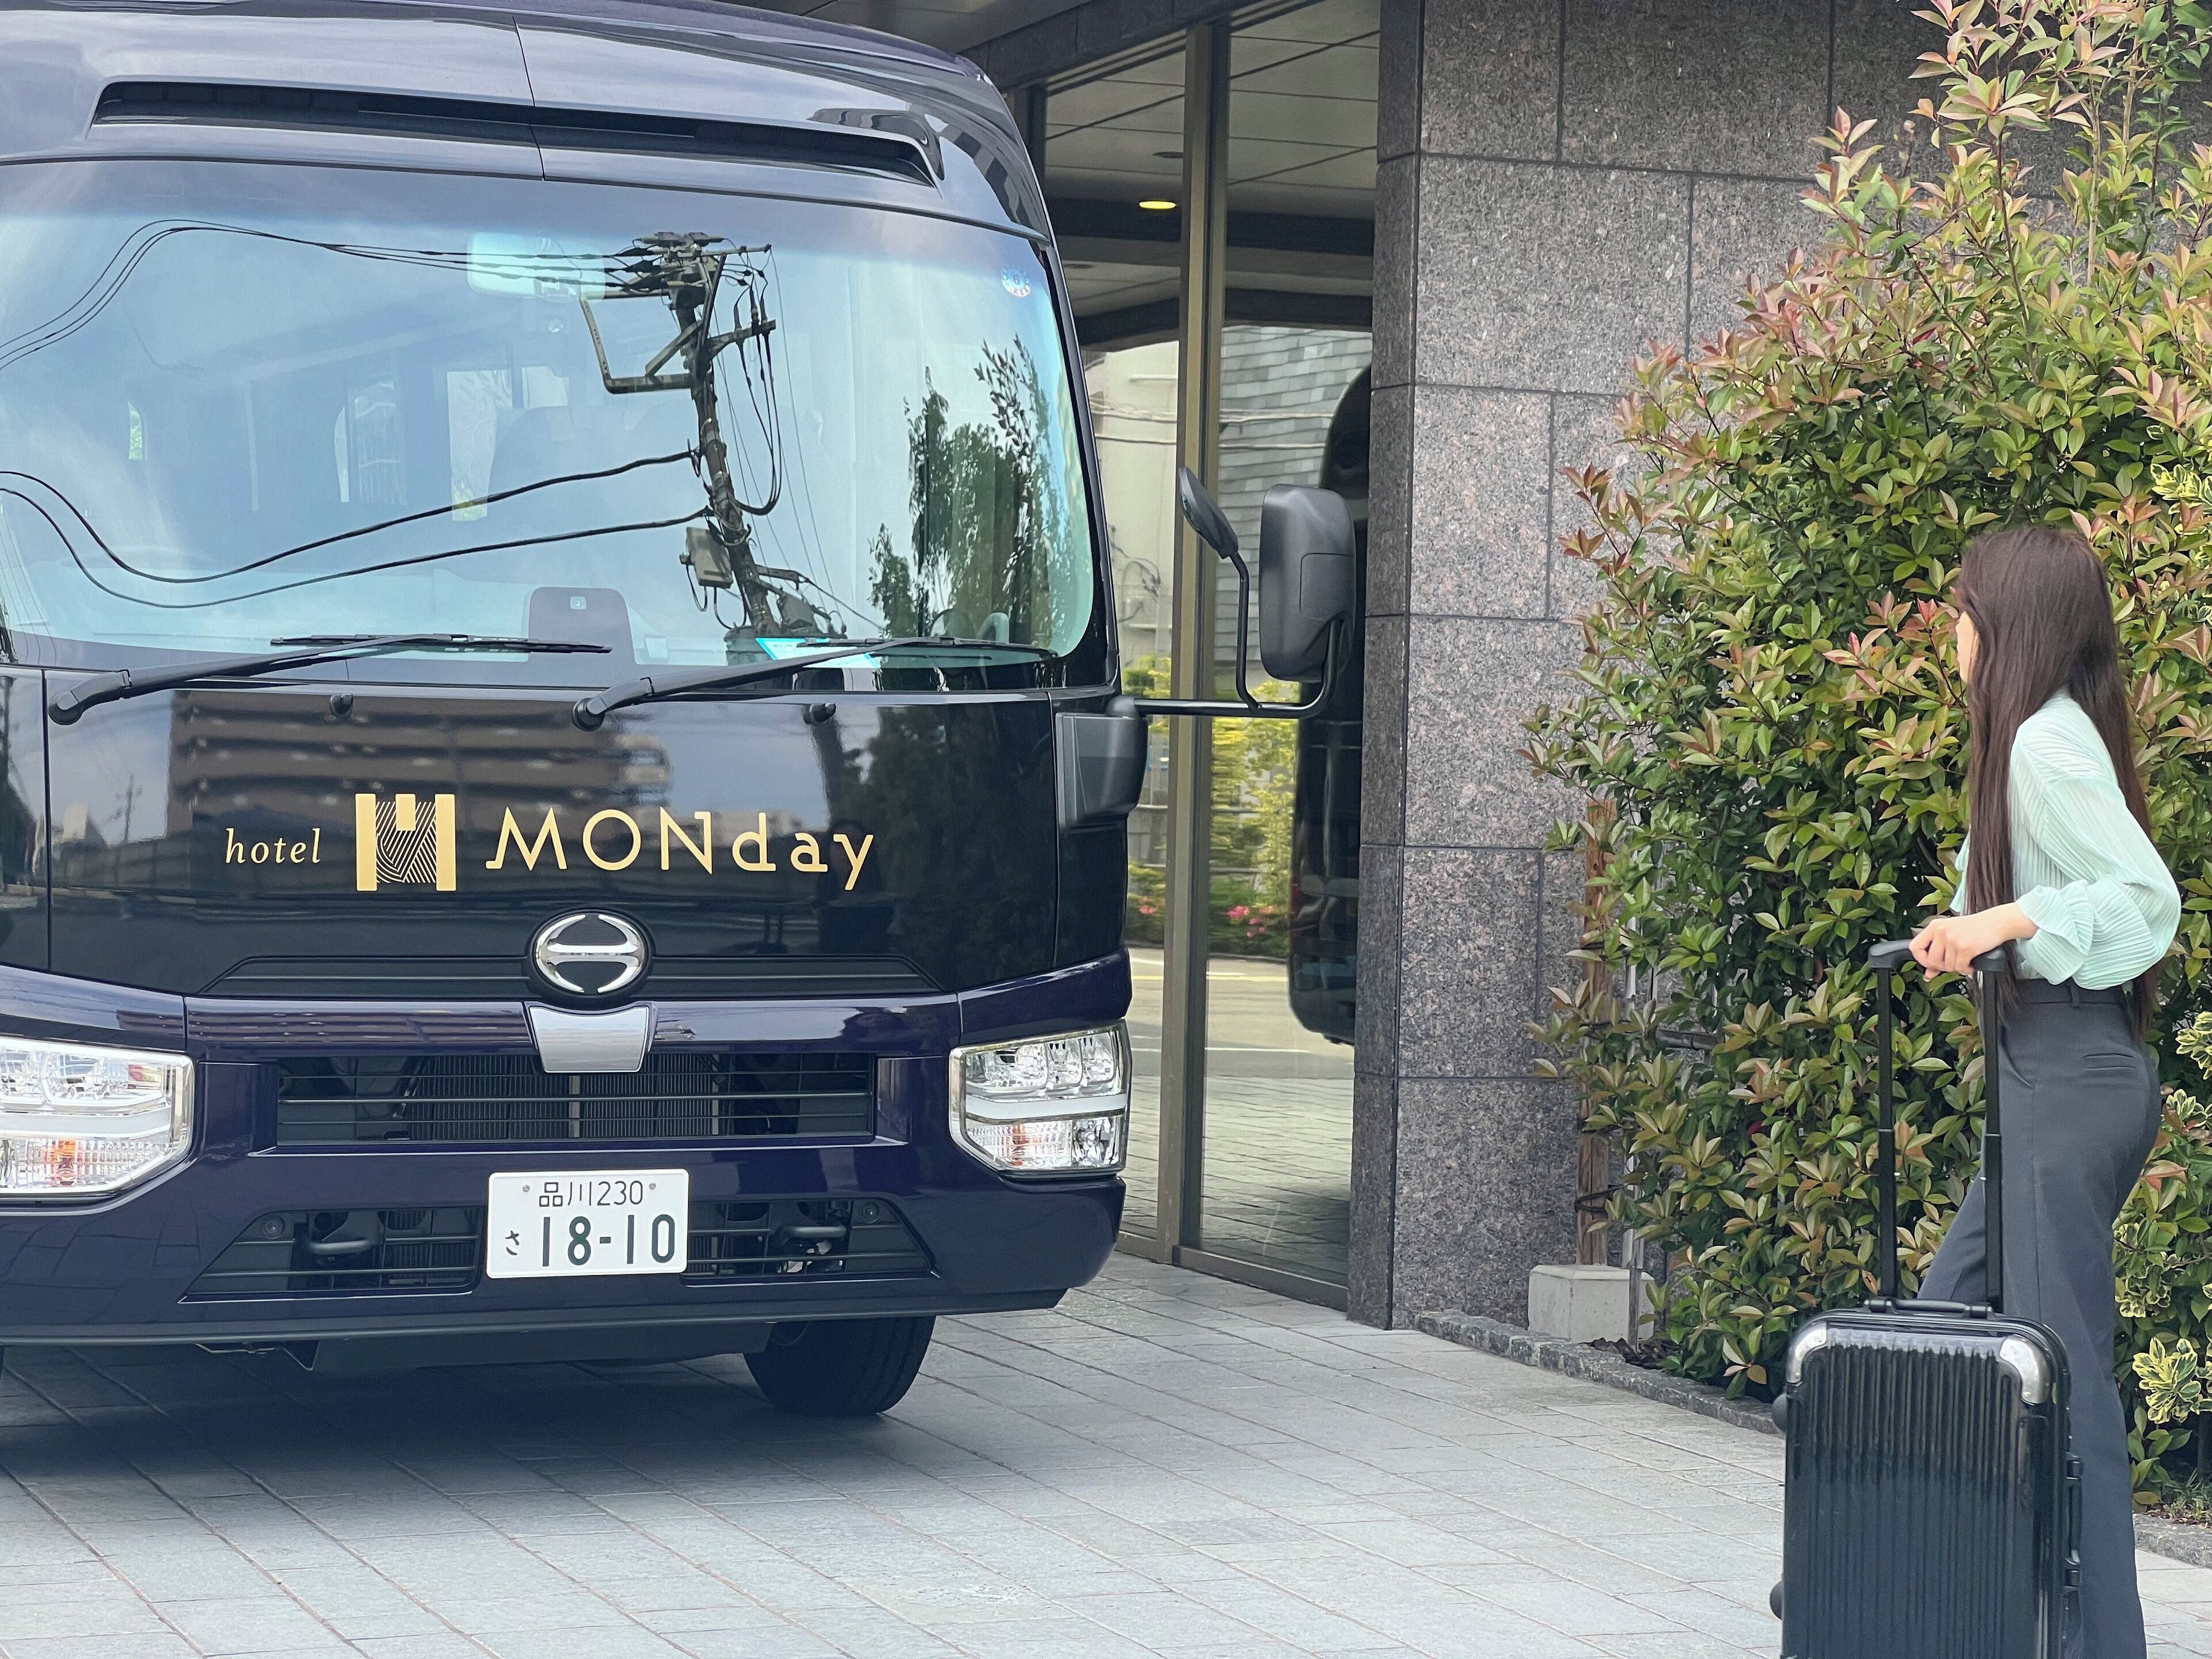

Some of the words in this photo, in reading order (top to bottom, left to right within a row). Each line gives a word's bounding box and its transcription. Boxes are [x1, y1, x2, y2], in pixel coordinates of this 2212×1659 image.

[225, 828, 321, 863] hotel
[486, 806, 874, 891] MONday
[539, 1180, 643, 1207] 品川230
[505, 1230, 520, 1256] さ
[542, 1214, 676, 1267] 18-10
